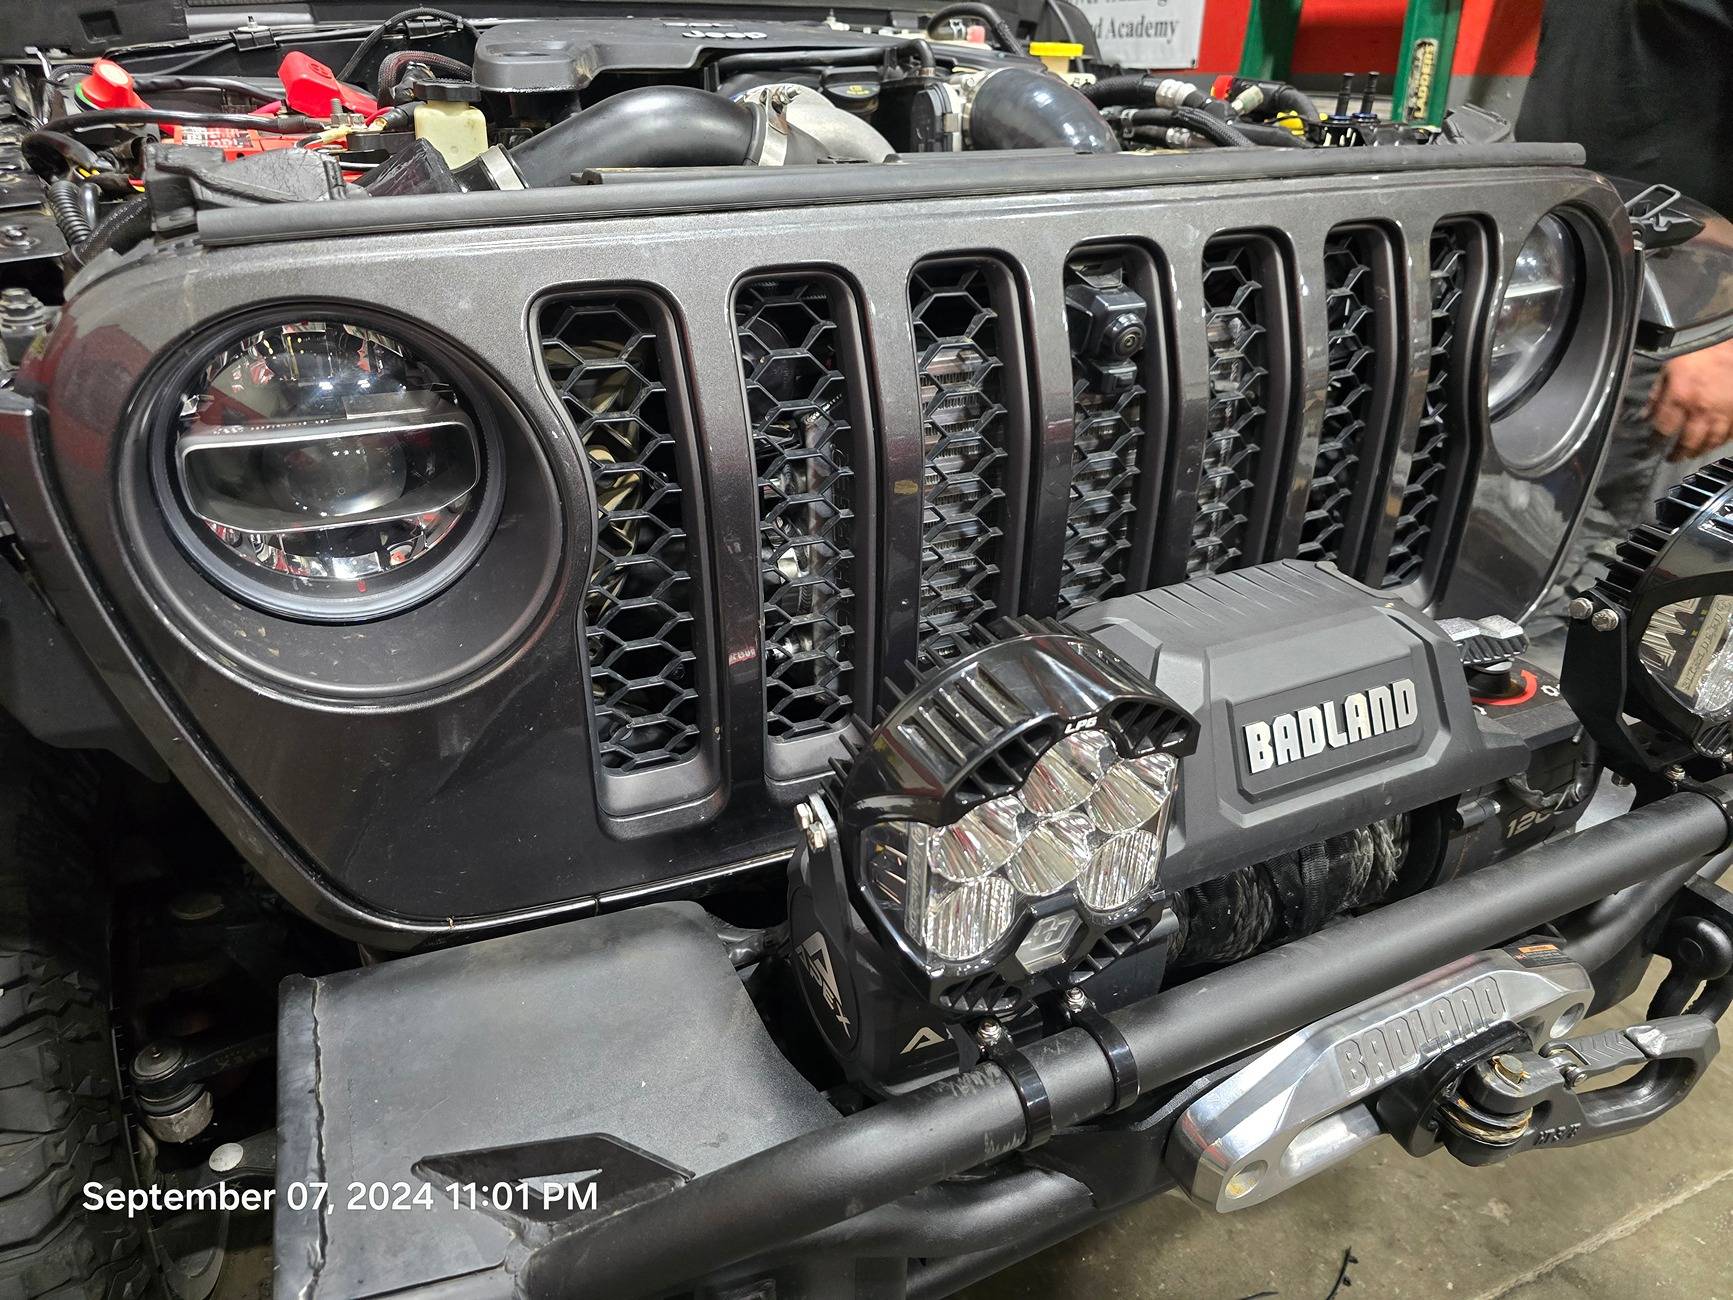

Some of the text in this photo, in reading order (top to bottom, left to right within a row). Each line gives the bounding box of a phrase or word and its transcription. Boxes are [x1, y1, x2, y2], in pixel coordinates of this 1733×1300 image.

[1106, 14, 1179, 44] Academy
[1413, 44, 1434, 118] LADDERS
[1243, 678, 1418, 774] BADLAND
[1335, 976, 1507, 1097] BADLAND
